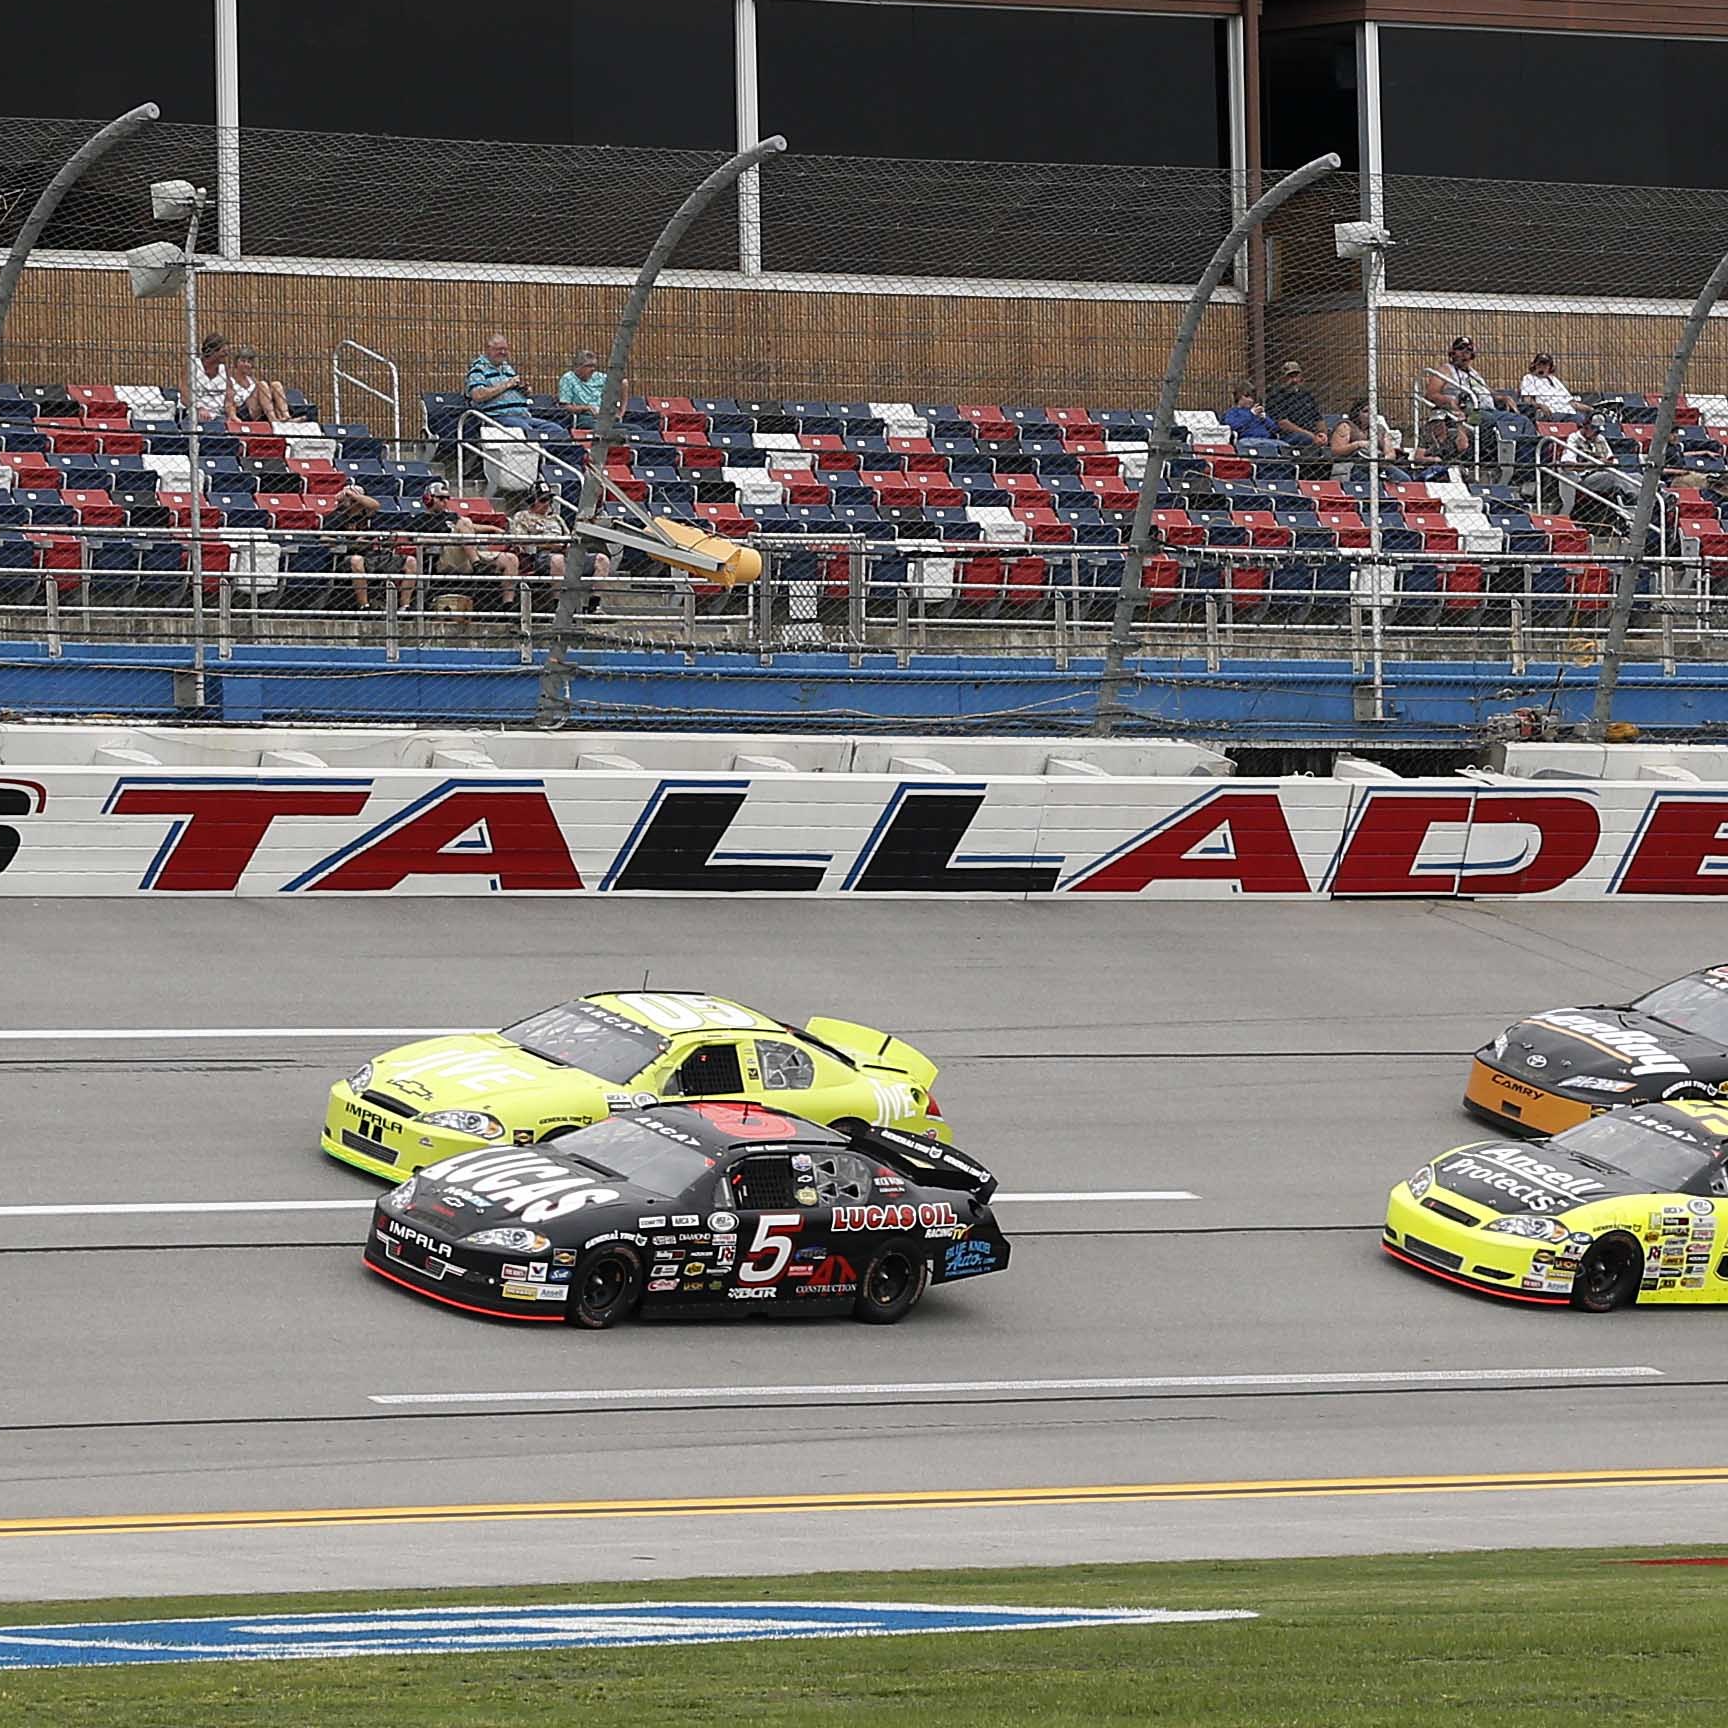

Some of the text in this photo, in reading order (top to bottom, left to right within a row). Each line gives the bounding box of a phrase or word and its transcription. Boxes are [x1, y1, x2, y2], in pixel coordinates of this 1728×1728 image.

[580, 1007, 634, 1031] ARCA
[1528, 1007, 1691, 1077] LeeBoy
[1491, 1073, 1545, 1100] CAMRY
[345, 1101, 403, 1135] IMPALA
[635, 1117, 691, 1143] ARCA
[1628, 1115, 1687, 1141] ARCA
[420, 1146, 620, 1223] LUCAS
[1442, 1158, 1556, 1213] Protects
[1480, 1148, 1605, 1195] Ansell
[831, 1202, 959, 1232] LUCAS OIL
[389, 1220, 453, 1258] IMPALA
[738, 1214, 805, 1285] 5
[795, 1283, 858, 1294] CONSTRUCTION
